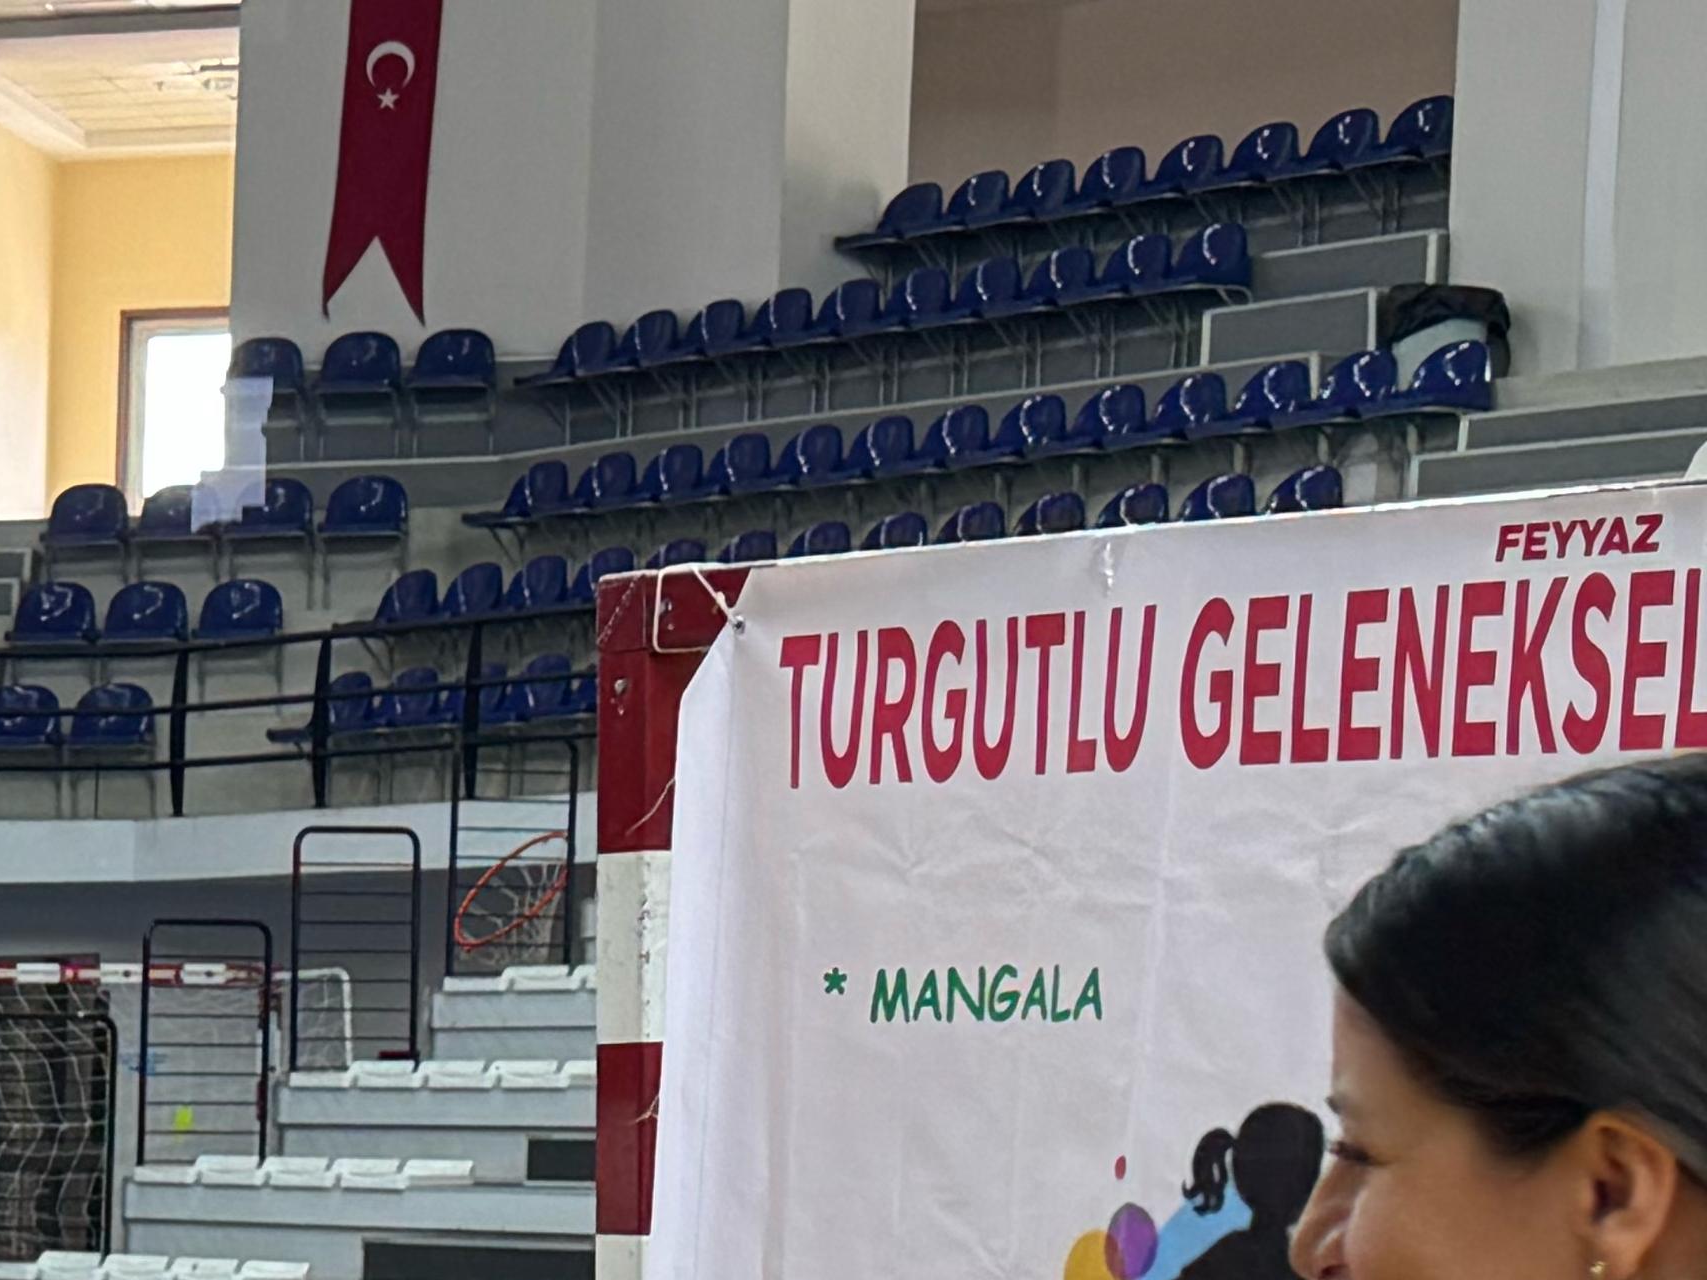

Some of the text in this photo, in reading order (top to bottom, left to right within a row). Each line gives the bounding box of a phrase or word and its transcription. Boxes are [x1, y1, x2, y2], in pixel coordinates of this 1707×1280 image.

[1495, 514, 1664, 562] FEYYAZ
[779, 567, 1707, 790] TURGUTLU GELENEKSEL
[870, 964, 1103, 1025] MANGALA
